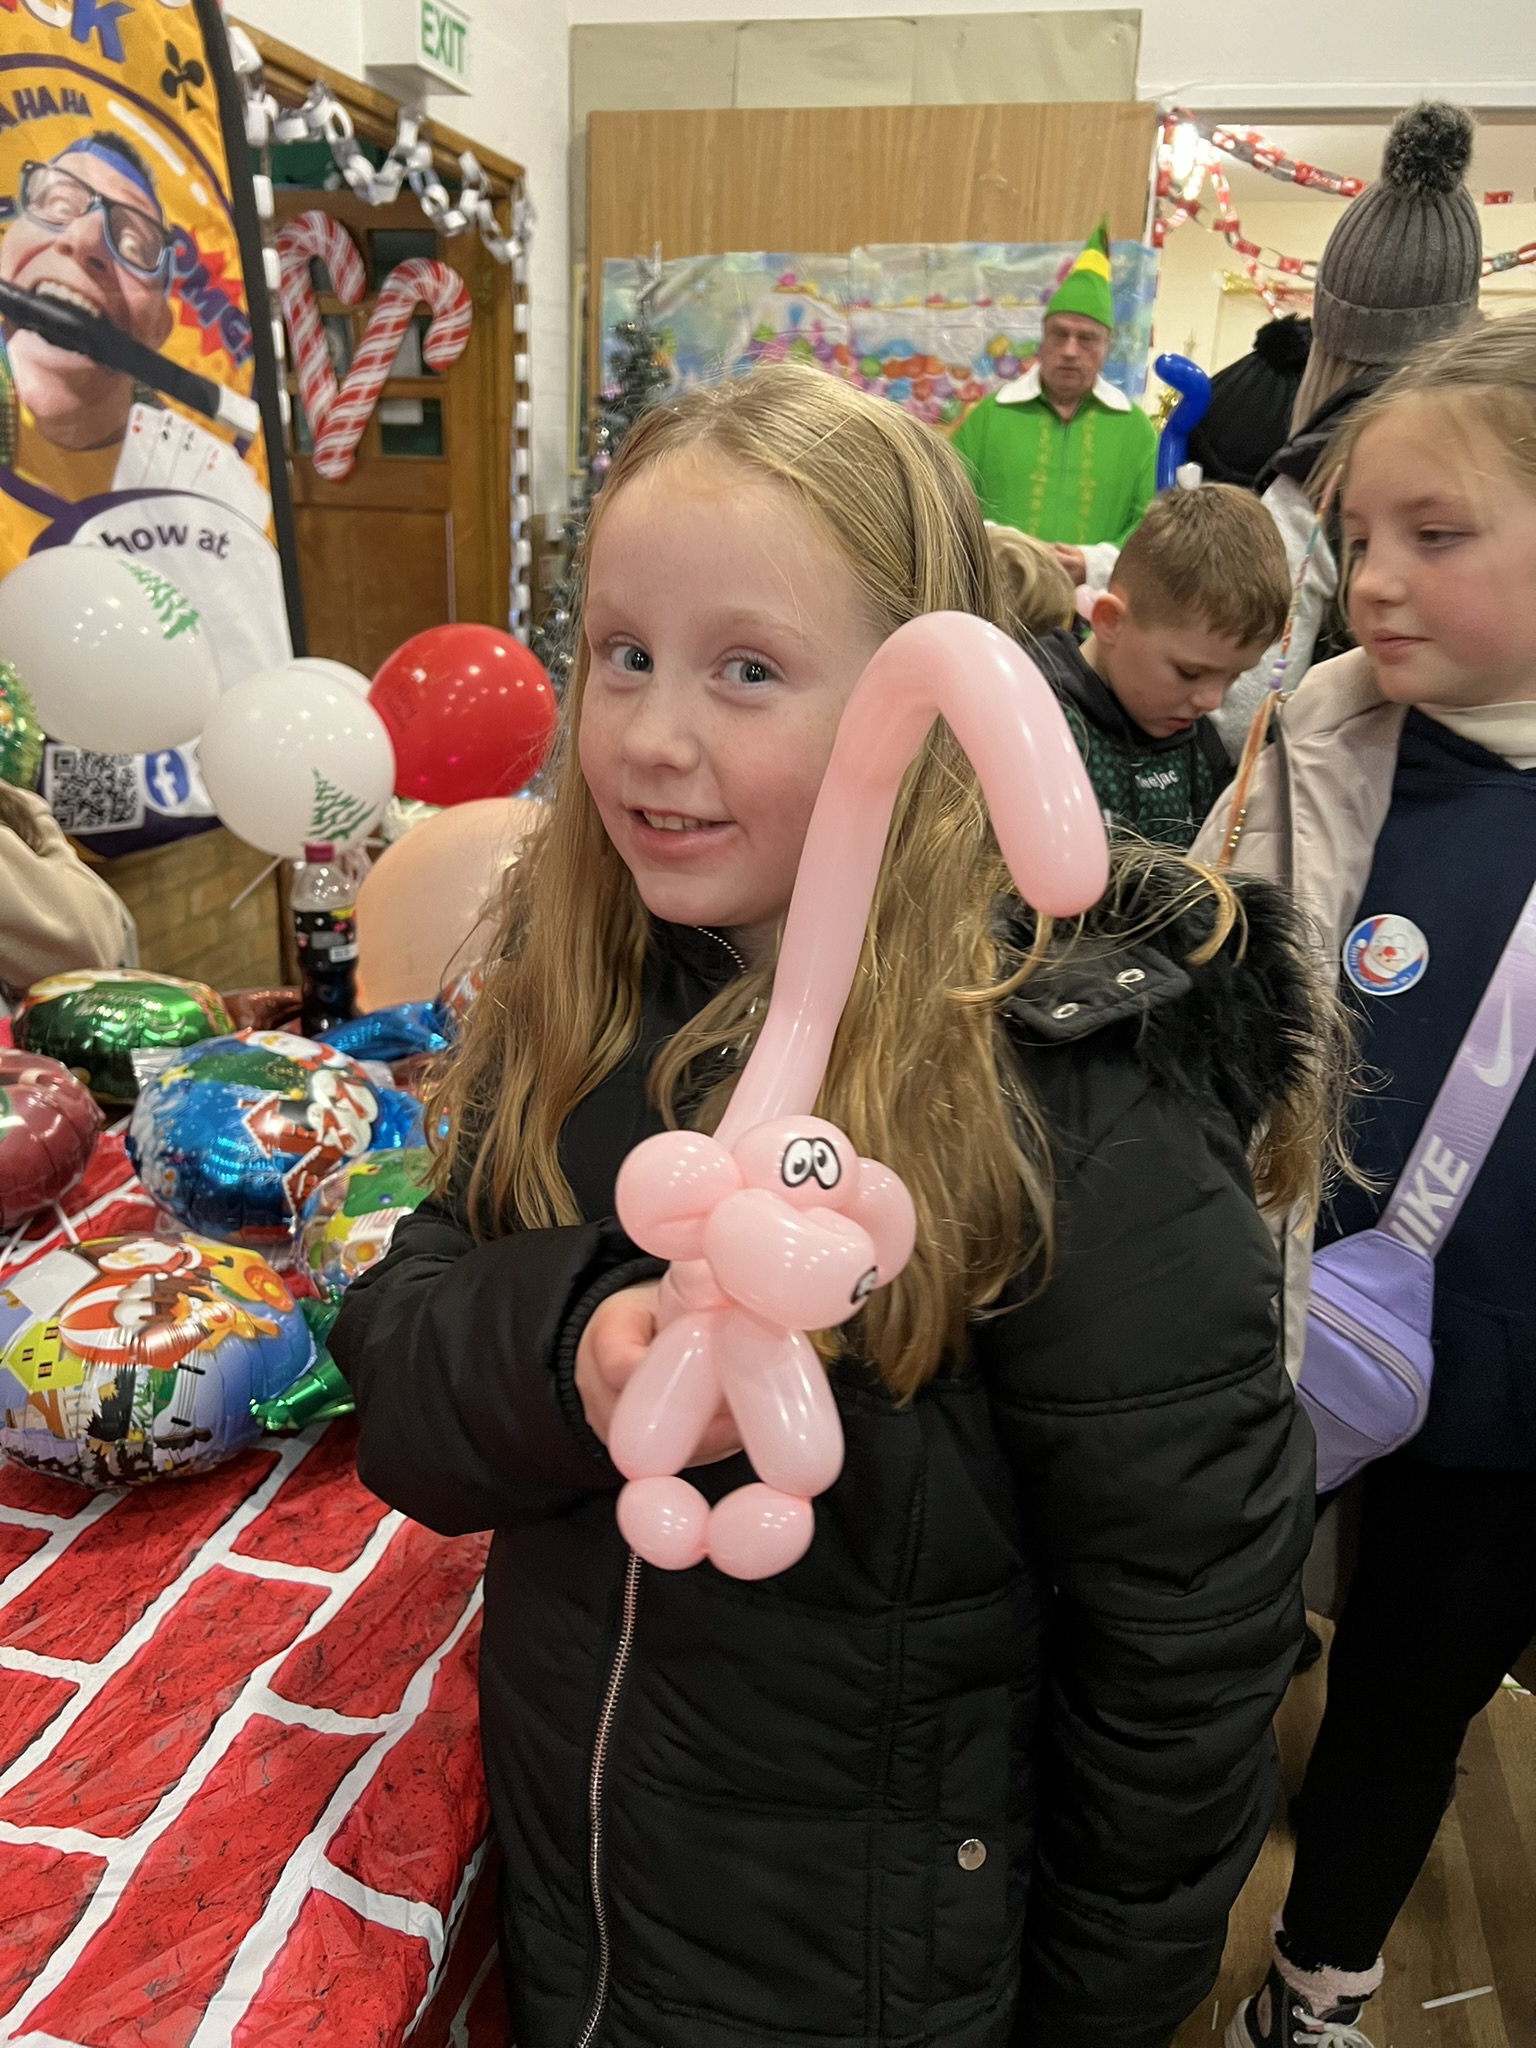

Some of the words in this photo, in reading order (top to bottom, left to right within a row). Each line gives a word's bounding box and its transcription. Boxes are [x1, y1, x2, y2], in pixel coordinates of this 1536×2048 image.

[421, 1, 466, 73] EXIT
[98, 524, 189, 554] how
[197, 528, 230, 560] at
